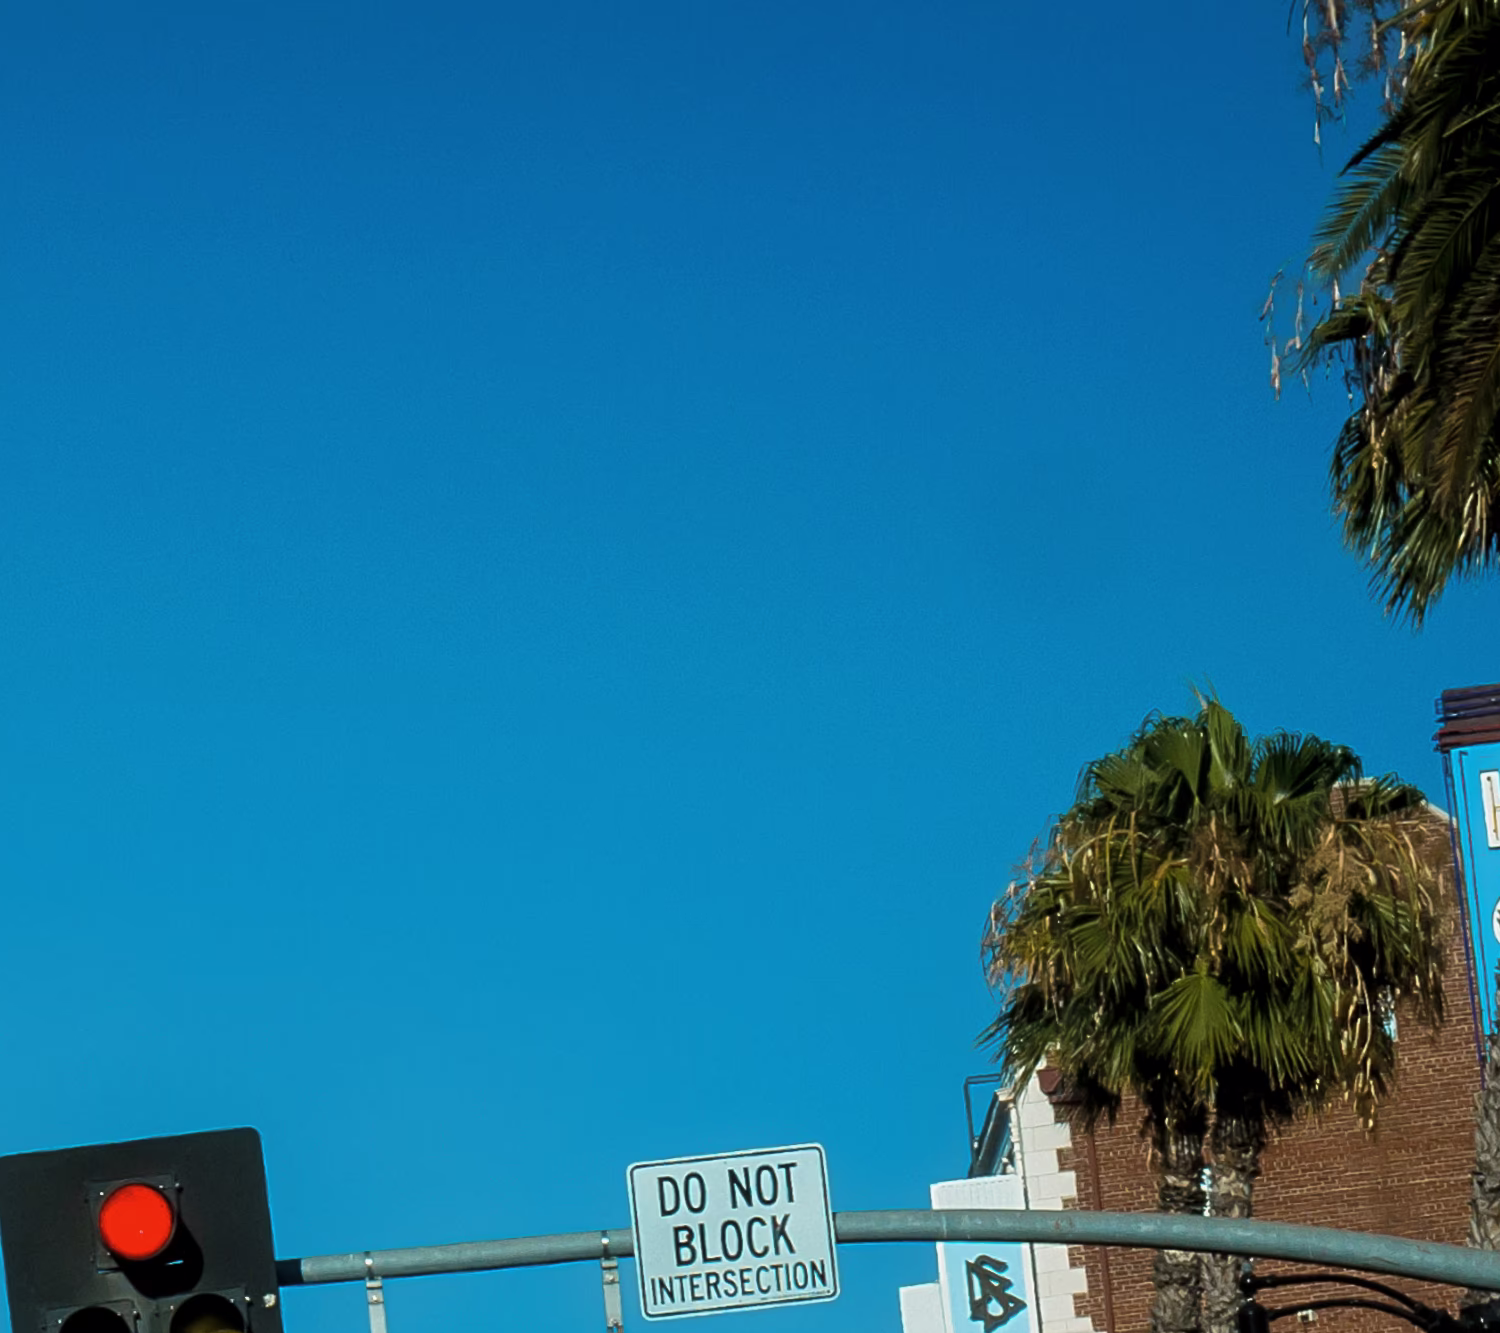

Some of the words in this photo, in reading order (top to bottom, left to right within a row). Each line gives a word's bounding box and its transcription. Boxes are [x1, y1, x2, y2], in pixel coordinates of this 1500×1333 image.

[657, 1172, 706, 1217] DO
[728, 1162, 797, 1209] NOT
[673, 1213, 796, 1267] BLOCK
[651, 1259, 827, 1306] INTERSECTION
